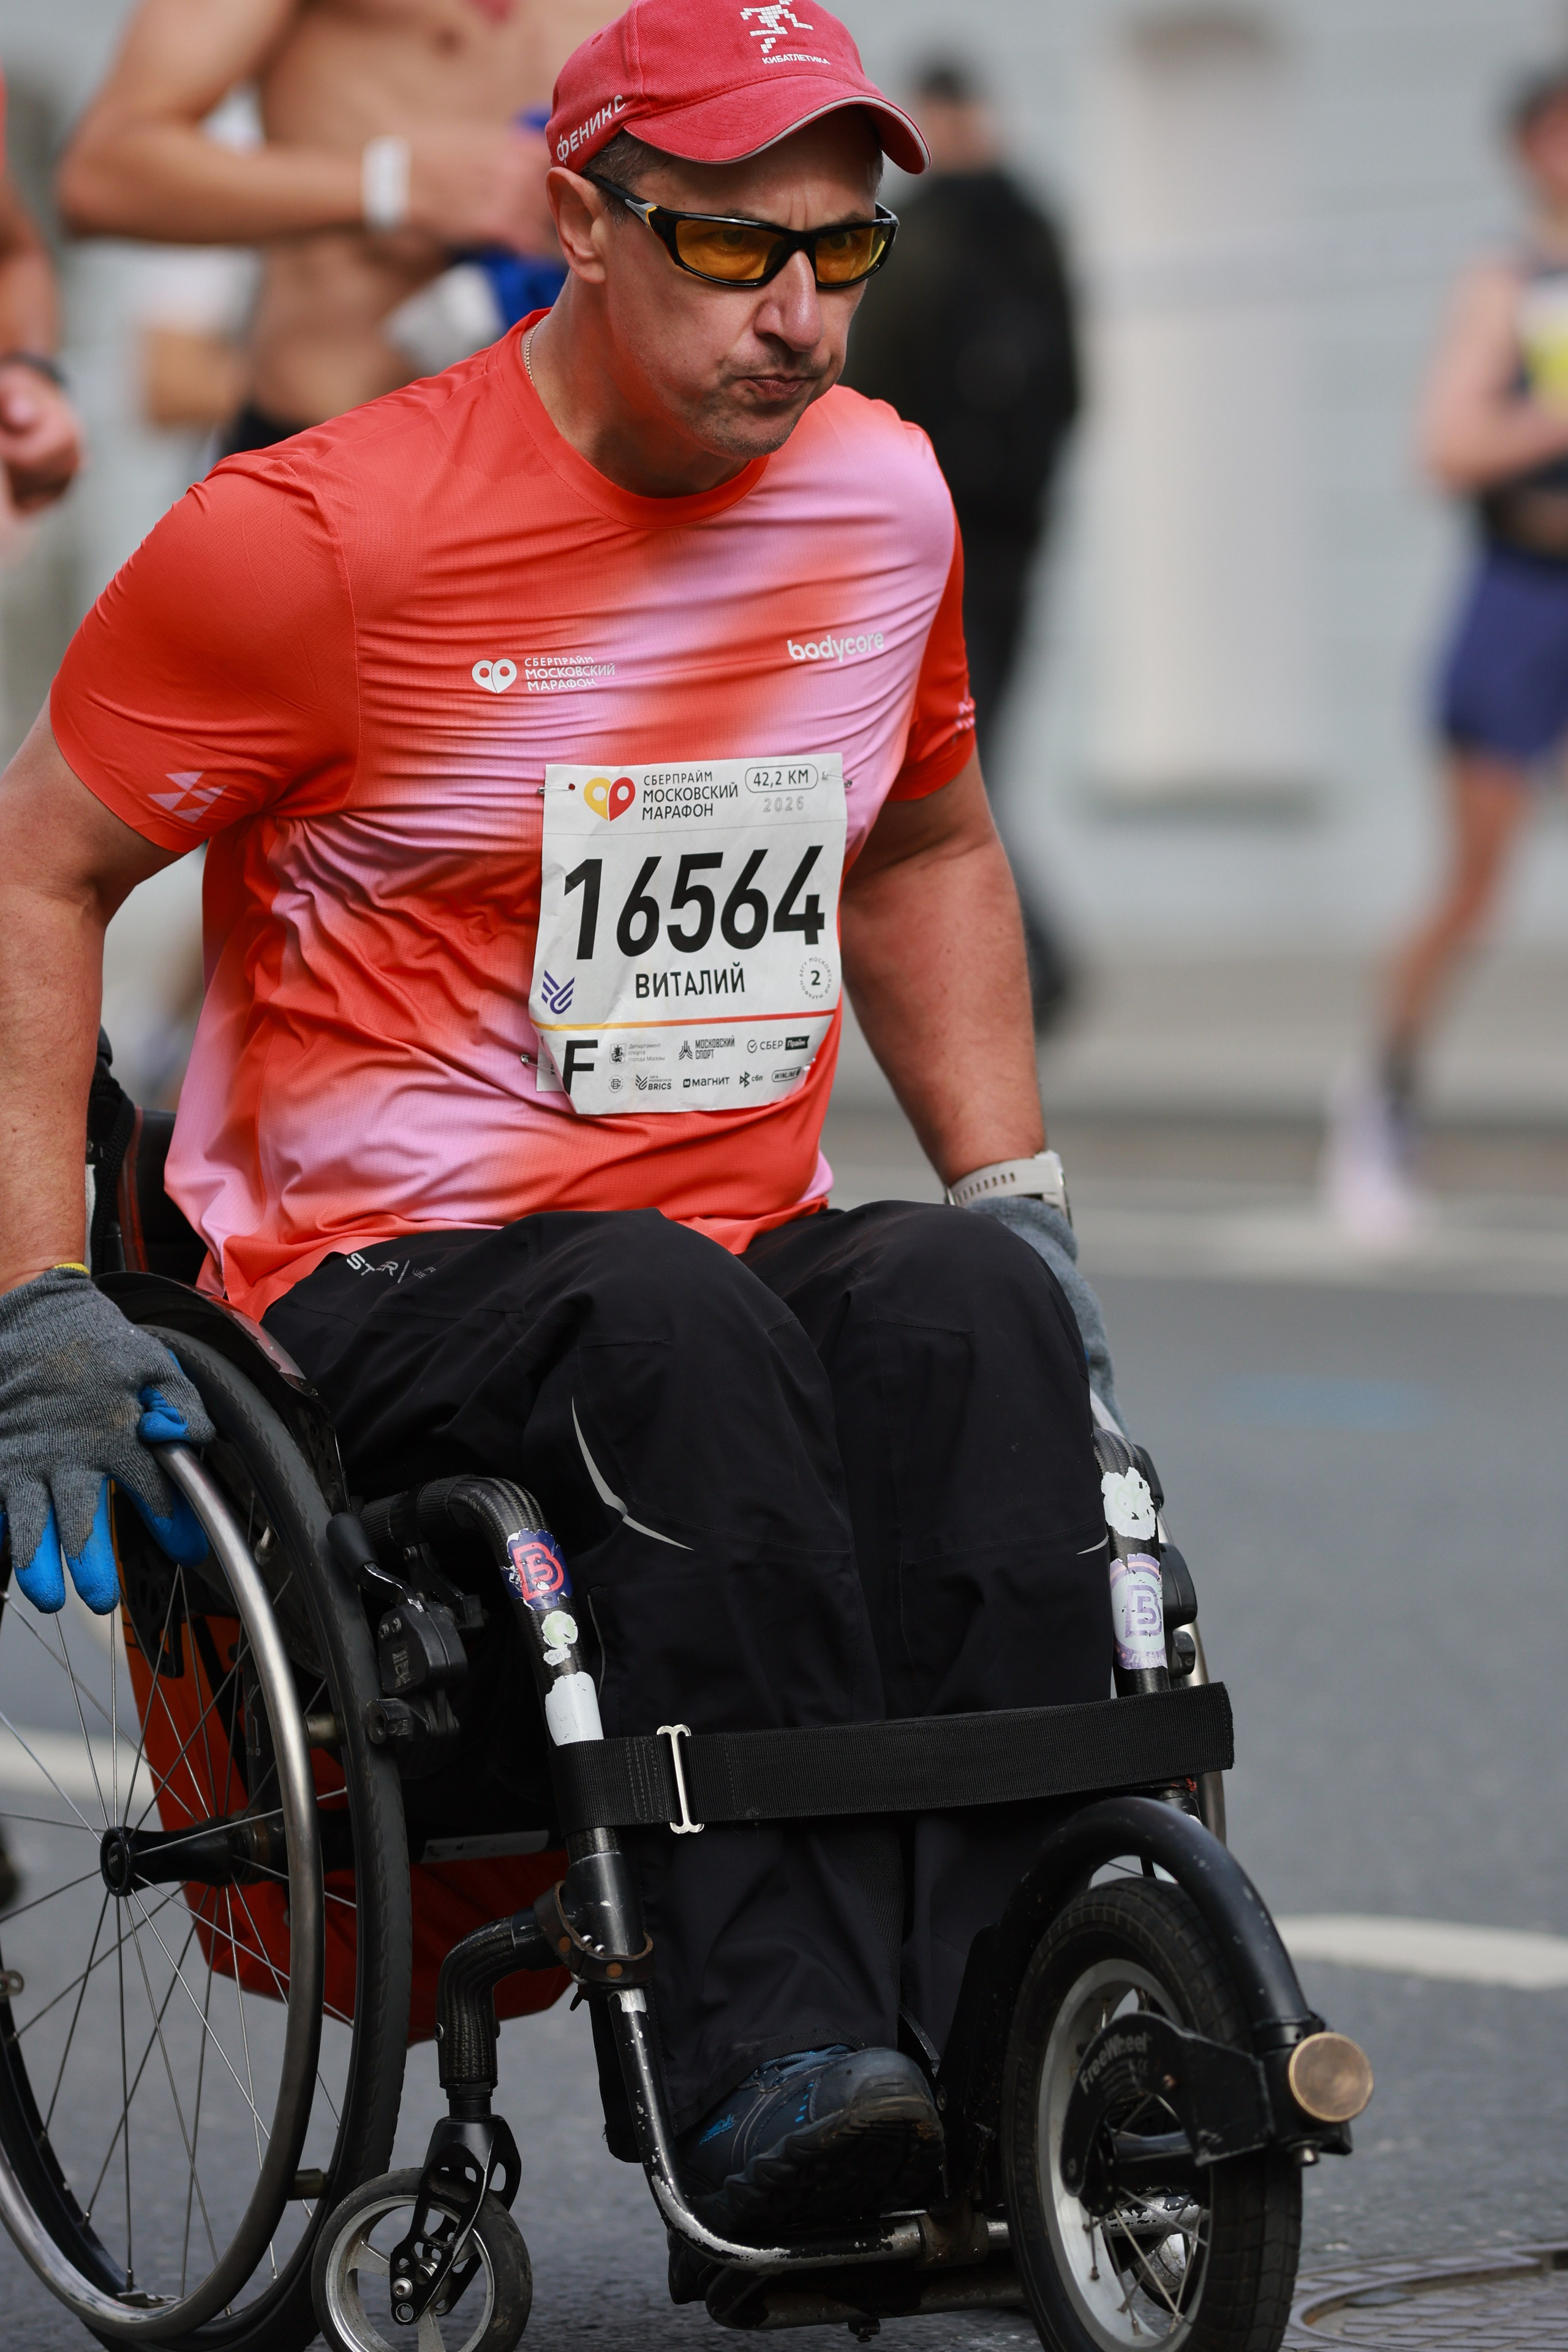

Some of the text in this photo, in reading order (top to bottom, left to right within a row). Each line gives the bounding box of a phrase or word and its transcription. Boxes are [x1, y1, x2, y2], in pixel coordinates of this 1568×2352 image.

[761, 53, 831, 65] КИБАТЛЕТИКА
[556, 94, 626, 166] ФЕНИКС
[787, 631, 884, 663] bodycore
[524, 655, 594, 667] СБЕРПРАЙМ
[525, 663, 616, 680] МОСКОВСКИЙ
[527, 678, 598, 692] МАРАФОН
[644, 769, 713, 786] СБЕРПРАЙМ
[753, 769, 809, 788] 42,2 КМ
[643, 782, 738, 804] МОСКОВСКИЙ
[642, 803, 714, 821] МАРАФОН
[763, 796, 804, 813] 2026
[564, 845, 825, 960] 16564
[635, 961, 746, 999] ВИТАЛИЙ
[810, 970, 821, 986] 2
[695, 1036, 736, 1049] МОСКОВСКИЙ
[760, 1040, 783, 1050] СБЕР
[695, 1049, 714, 1060] СПОРТ
[562, 1039, 598, 1096] F
[692, 1077, 730, 1087] магнит
[1079, 2030, 1148, 2096] FreeWheel
